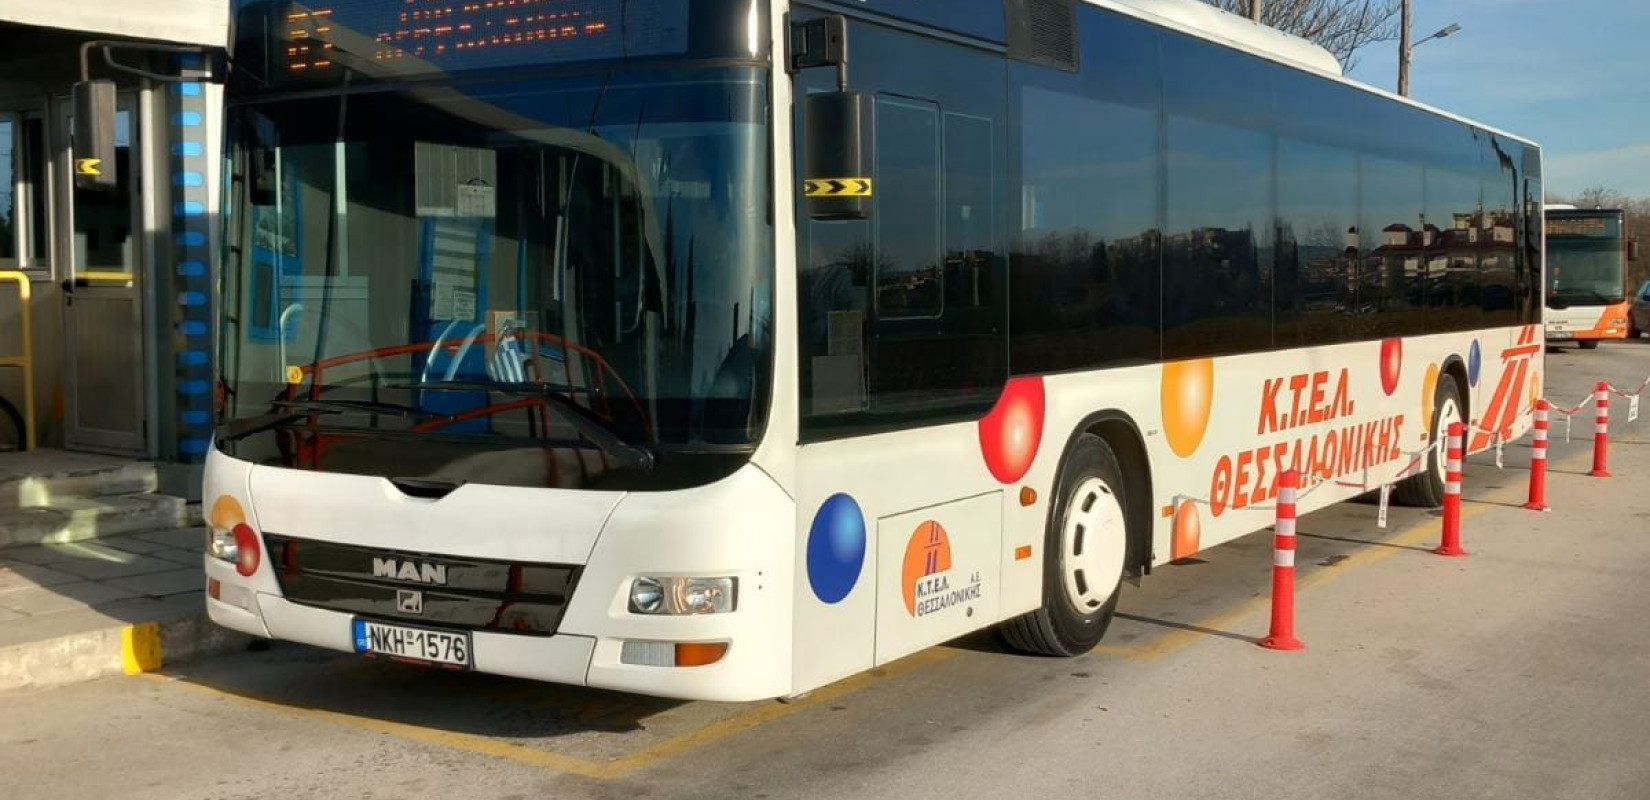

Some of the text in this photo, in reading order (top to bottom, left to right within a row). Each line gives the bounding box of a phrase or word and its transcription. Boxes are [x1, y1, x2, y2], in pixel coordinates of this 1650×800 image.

[1257, 368, 1355, 435] Κ.Τ.Ε.Λ.
[1210, 414, 1405, 517] ΘΕΣΣΑΛΟΝΙΚΗΣ
[373, 557, 446, 585] MAN
[917, 582, 981, 617] ΘΕΣΣΑΛΟΝΙΚΗΣ
